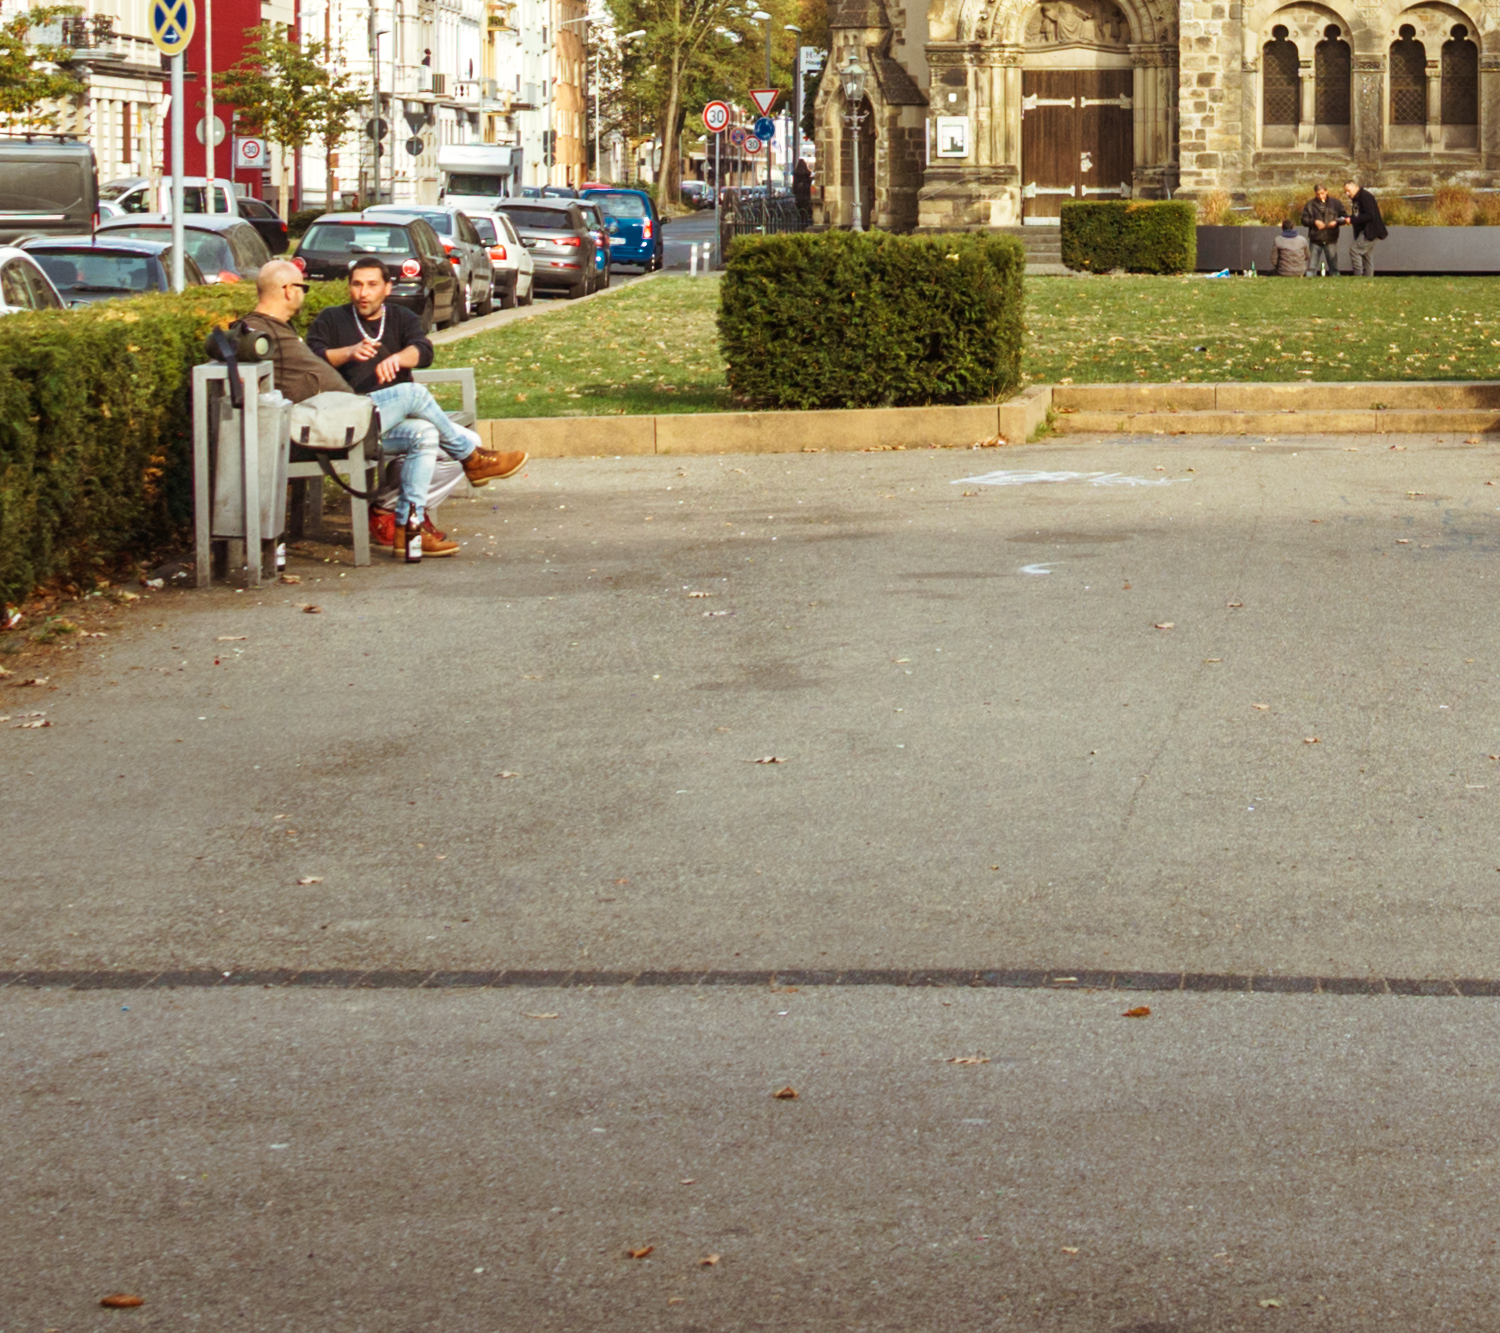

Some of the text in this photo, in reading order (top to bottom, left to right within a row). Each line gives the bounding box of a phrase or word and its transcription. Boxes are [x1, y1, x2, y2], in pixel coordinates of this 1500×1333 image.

[709, 109, 725, 123] 30
[747, 140, 759, 149] 30
[245, 145, 257, 154] 30
